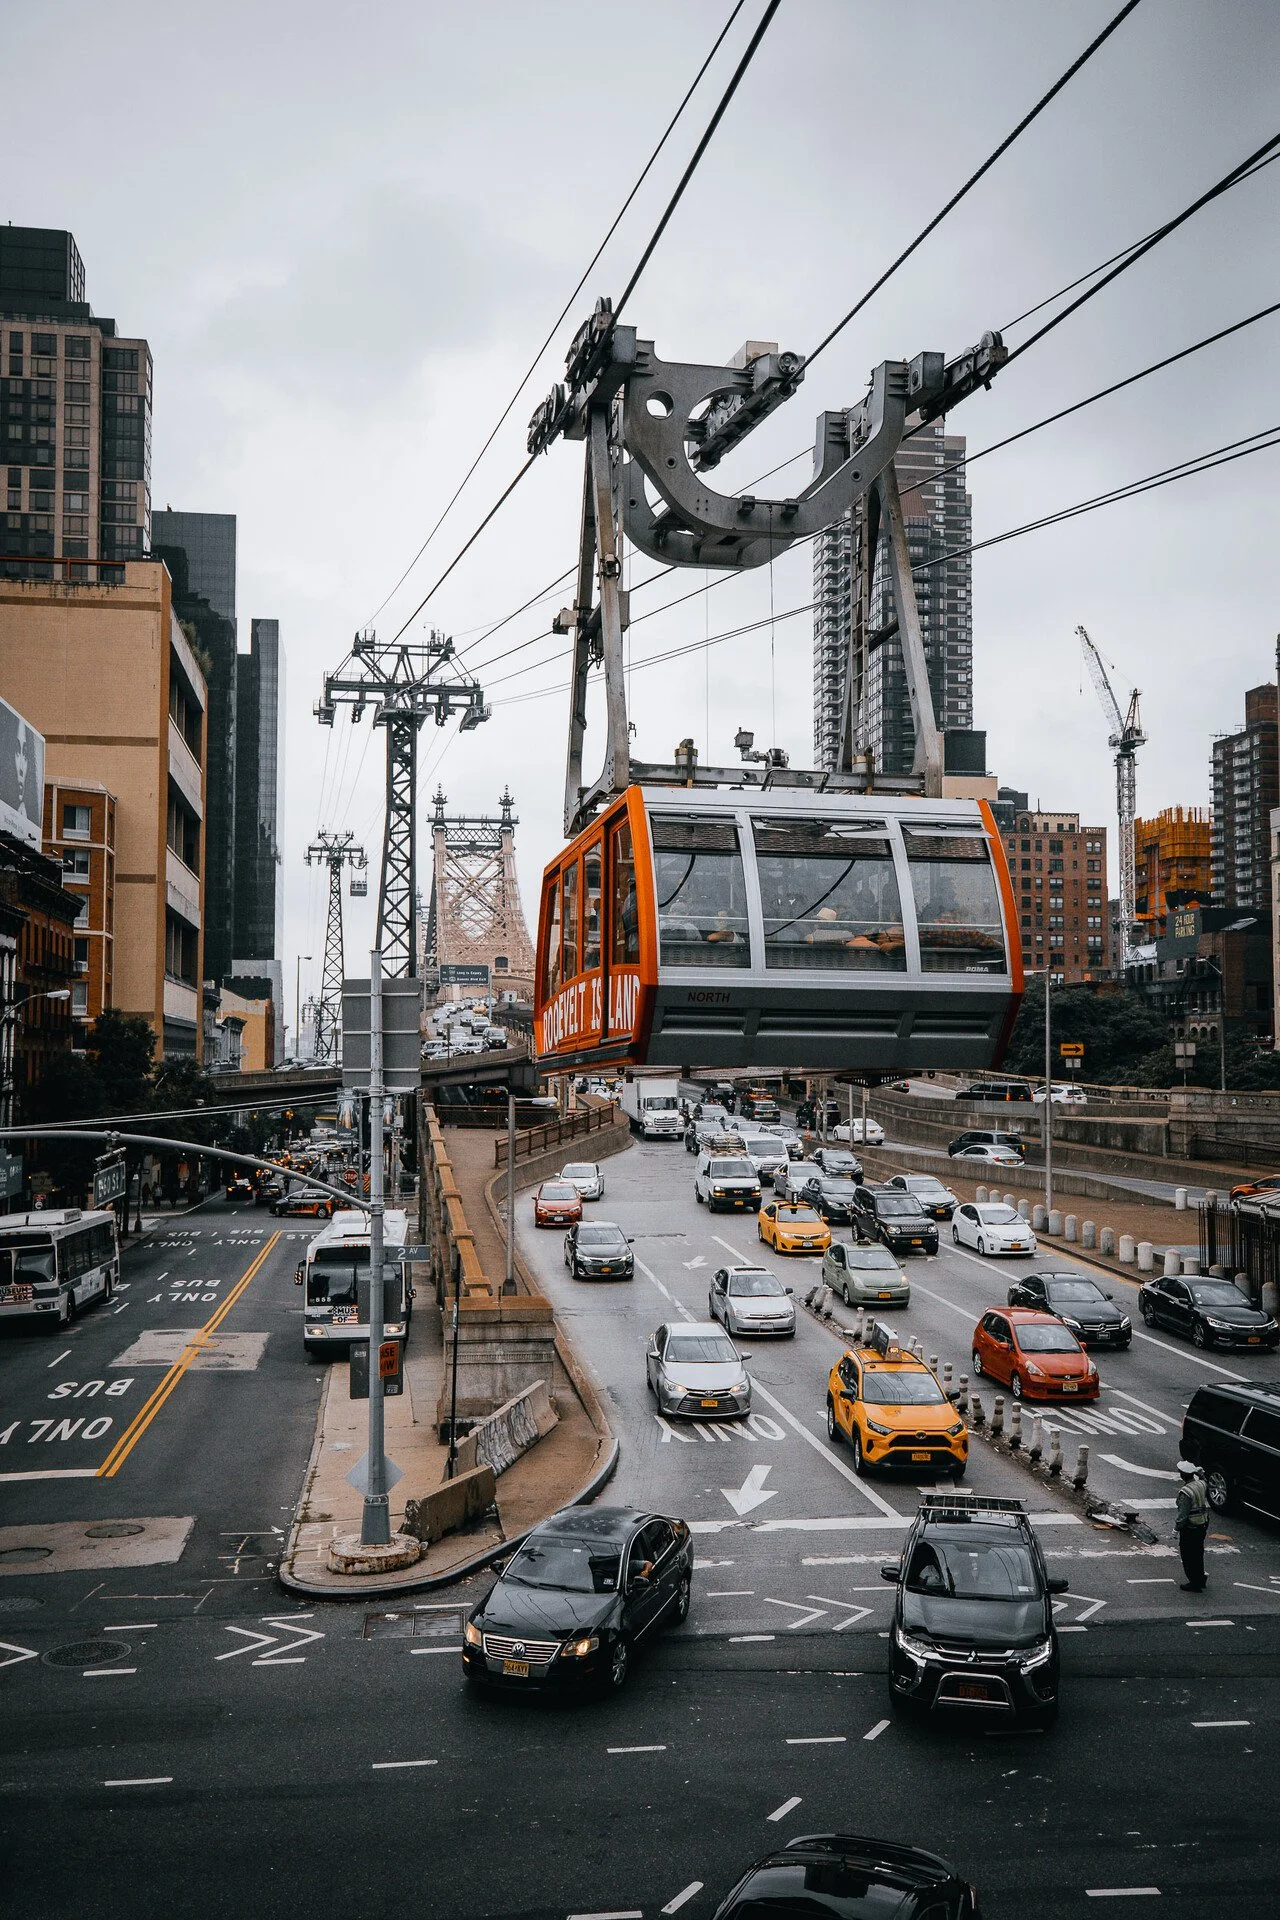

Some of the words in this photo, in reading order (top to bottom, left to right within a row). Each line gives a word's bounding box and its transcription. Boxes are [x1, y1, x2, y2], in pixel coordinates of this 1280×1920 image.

[1175, 915, 1182, 926] 24
[1184, 914, 1194, 925] HOUR
[1175, 925, 1195, 938] PARKING
[687, 991, 731, 1003] NORTH
[143, 1239, 193, 1248] ONLY
[397, 1247, 407, 1260] 2
[408, 1247, 420, 1255] AV
[170, 1279, 222, 1288] BUS
[146, 1292, 218, 1303] ONLY
[337, 1316, 349, 1324] OF
[47, 1378, 135, 1399] BUS
[0, 1416, 114, 1444] ONLY
